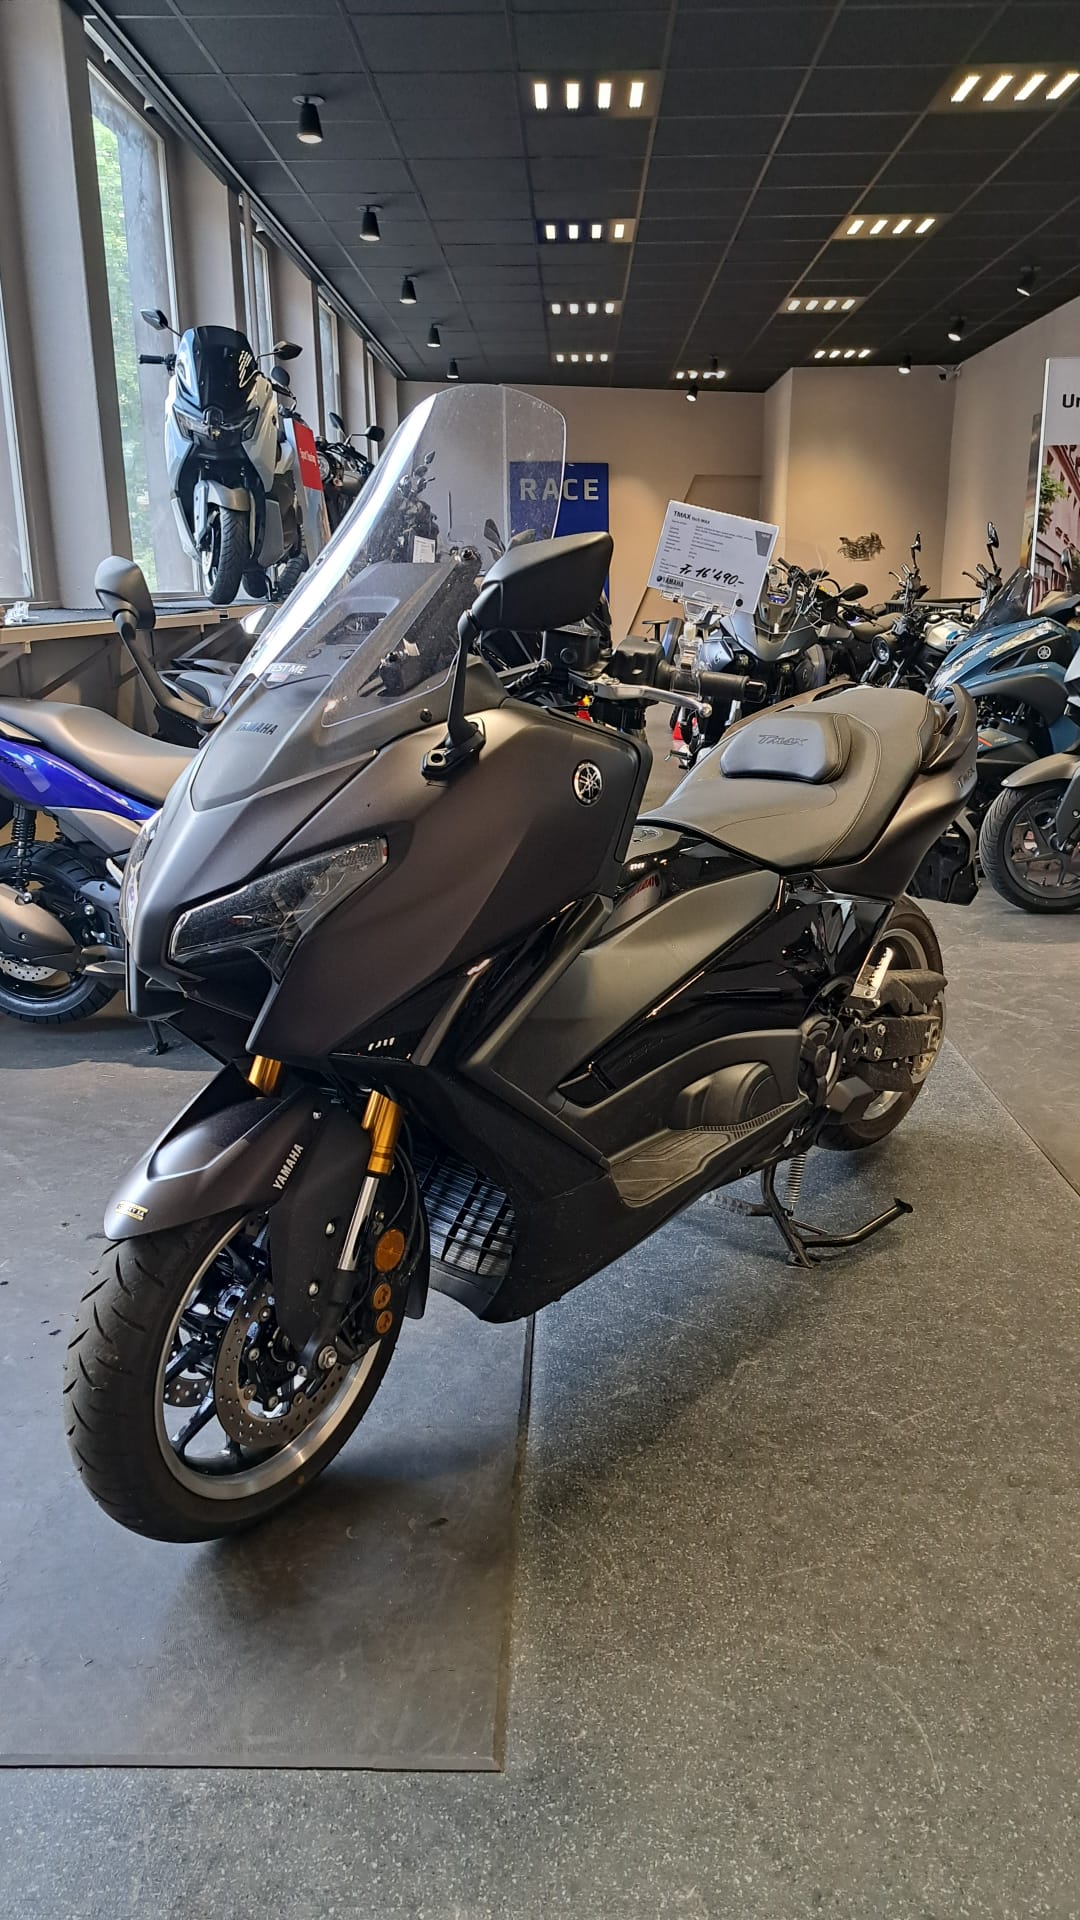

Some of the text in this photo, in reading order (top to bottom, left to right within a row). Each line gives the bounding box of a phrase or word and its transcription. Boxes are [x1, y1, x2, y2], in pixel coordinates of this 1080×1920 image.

[519, 477, 599, 501] RACE
[673, 510, 691, 520] TMAX
[662, 576, 684, 587] YAMAHA
[288, 664, 308, 674] ME
[236, 721, 278, 735] YAMAHA
[272, 1143, 304, 1190] YAMAHA
